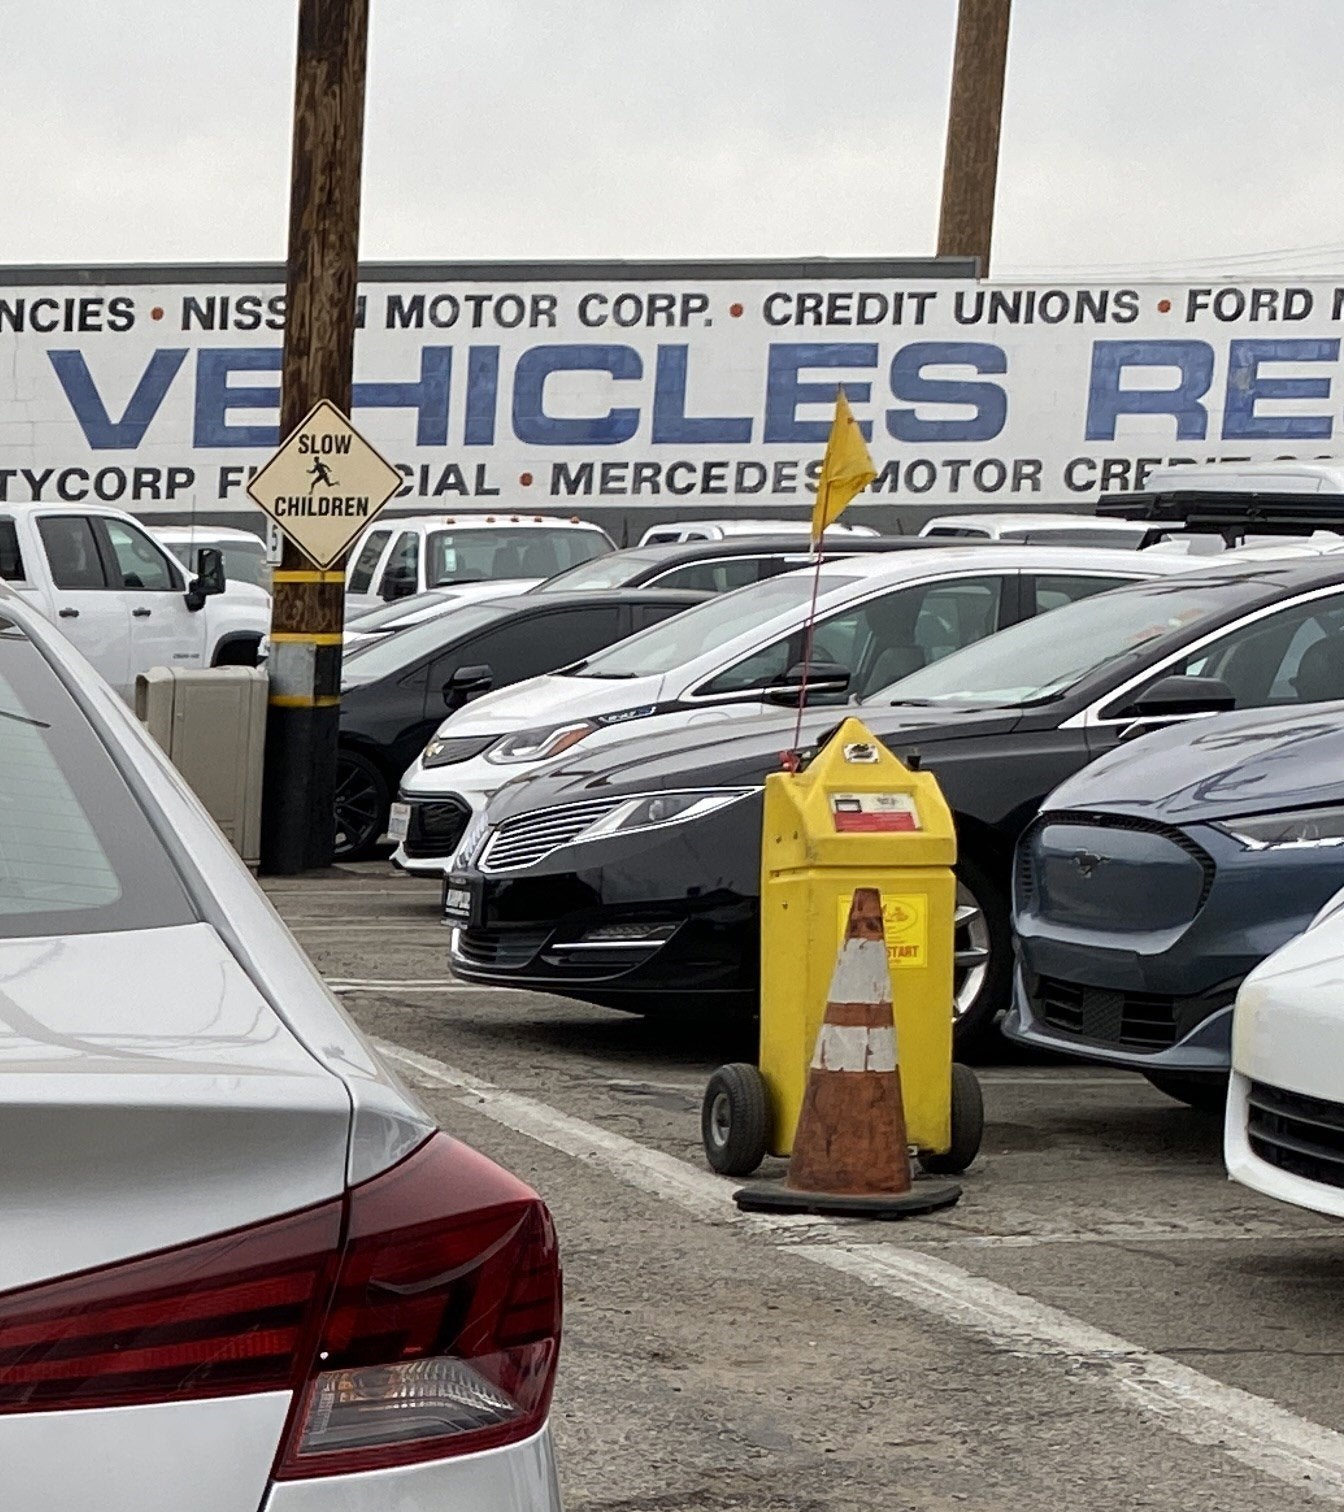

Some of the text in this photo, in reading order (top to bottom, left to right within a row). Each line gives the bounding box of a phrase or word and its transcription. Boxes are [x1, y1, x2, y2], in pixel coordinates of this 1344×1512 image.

[181, 295, 367, 331] NISS
[386, 294, 559, 330] MOTOR
[578, 293, 714, 329] CORP.
[763, 291, 939, 327] CREDIT
[954, 289, 1141, 326] UNIONS
[1185, 287, 1314, 324] FORD
[48, 341, 1011, 450] VEHICLES
[297, 433, 353, 455] SLOW
[274, 495, 370, 517] CHILDREN
